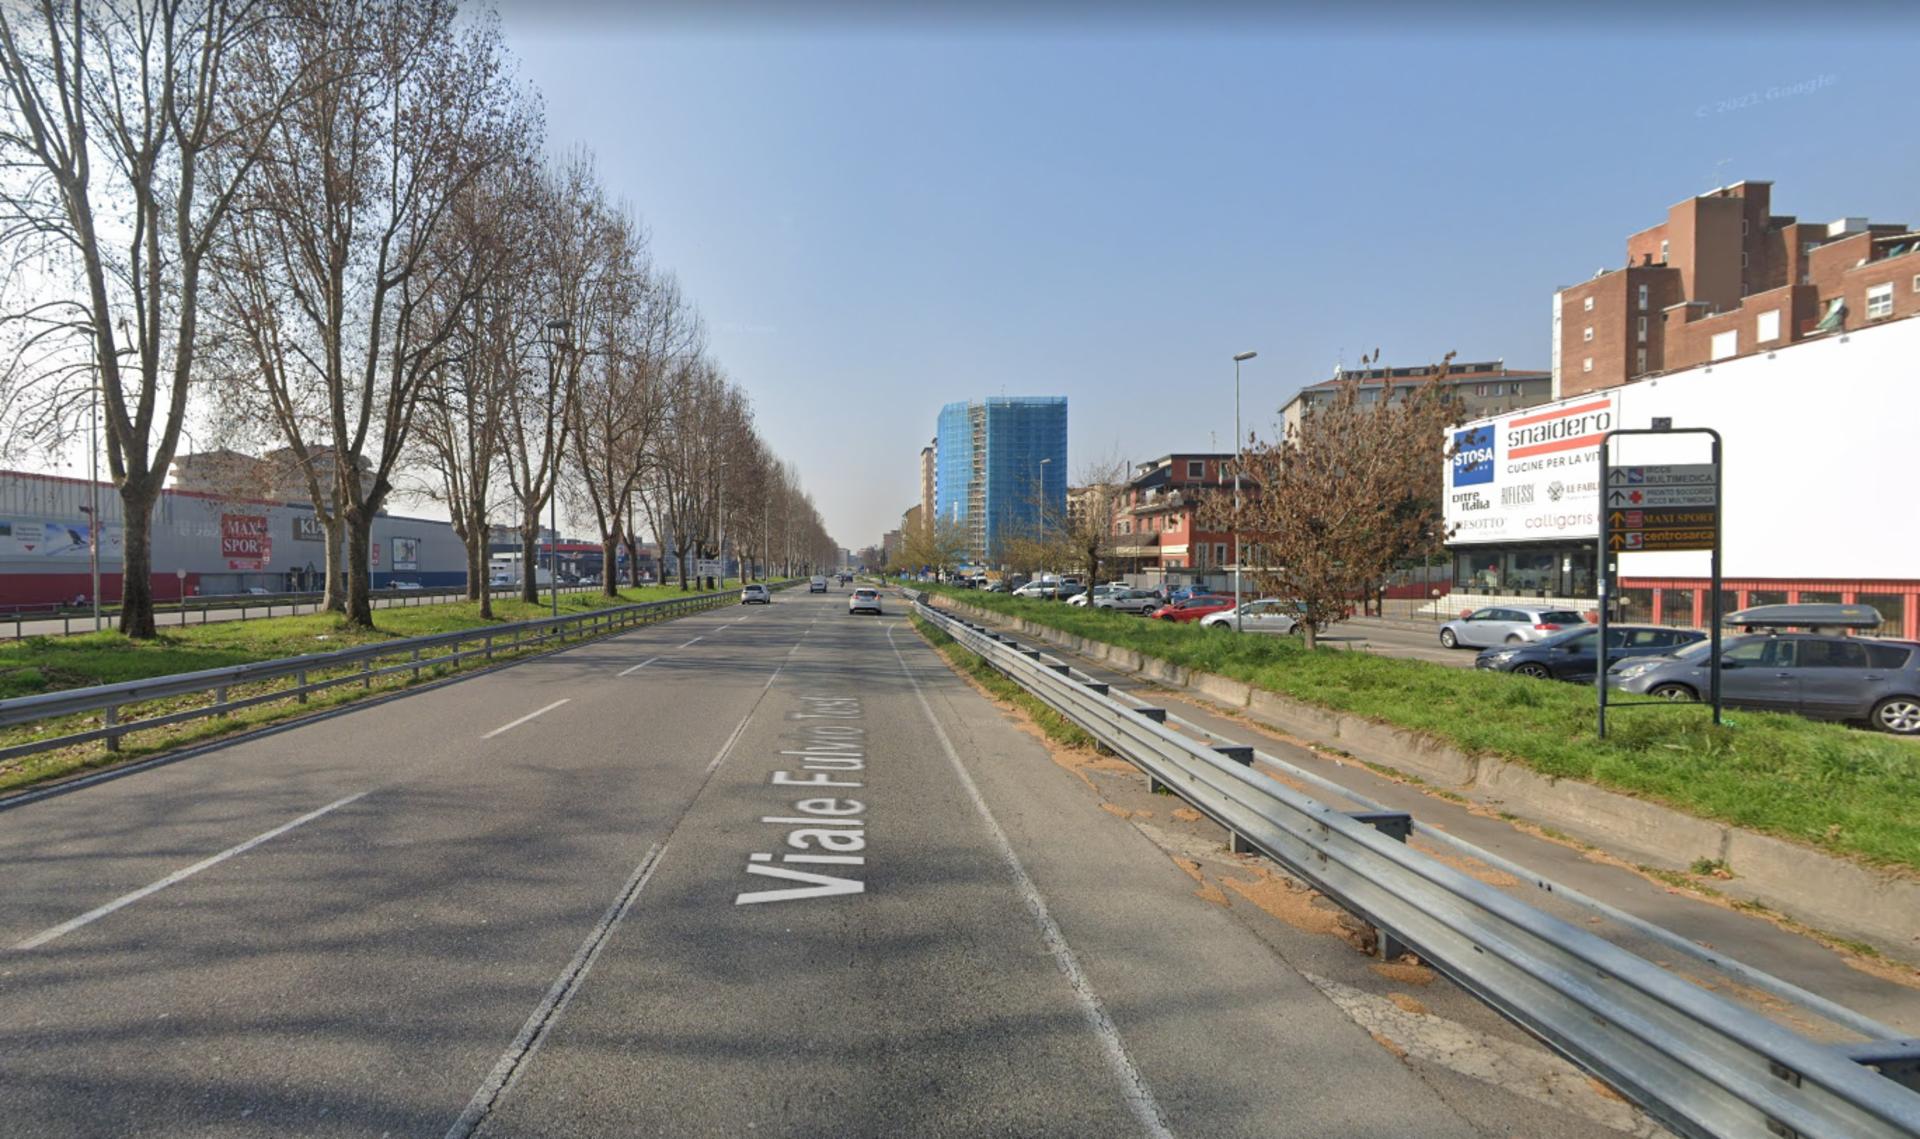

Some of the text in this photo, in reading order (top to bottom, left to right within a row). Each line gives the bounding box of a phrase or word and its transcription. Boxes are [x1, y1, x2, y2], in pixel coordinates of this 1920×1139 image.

[1507, 411, 1611, 448] snaidero
[1454, 447, 1494, 467] STOSA
[1507, 451, 1601, 474] CUCINE PER LA VIT
[1646, 473, 1713, 484] MULTIMEDICA
[1525, 512, 1593, 530] calligaris
[1678, 513, 1714, 523] SPORT
[1644, 531, 1714, 543] centrosarca
